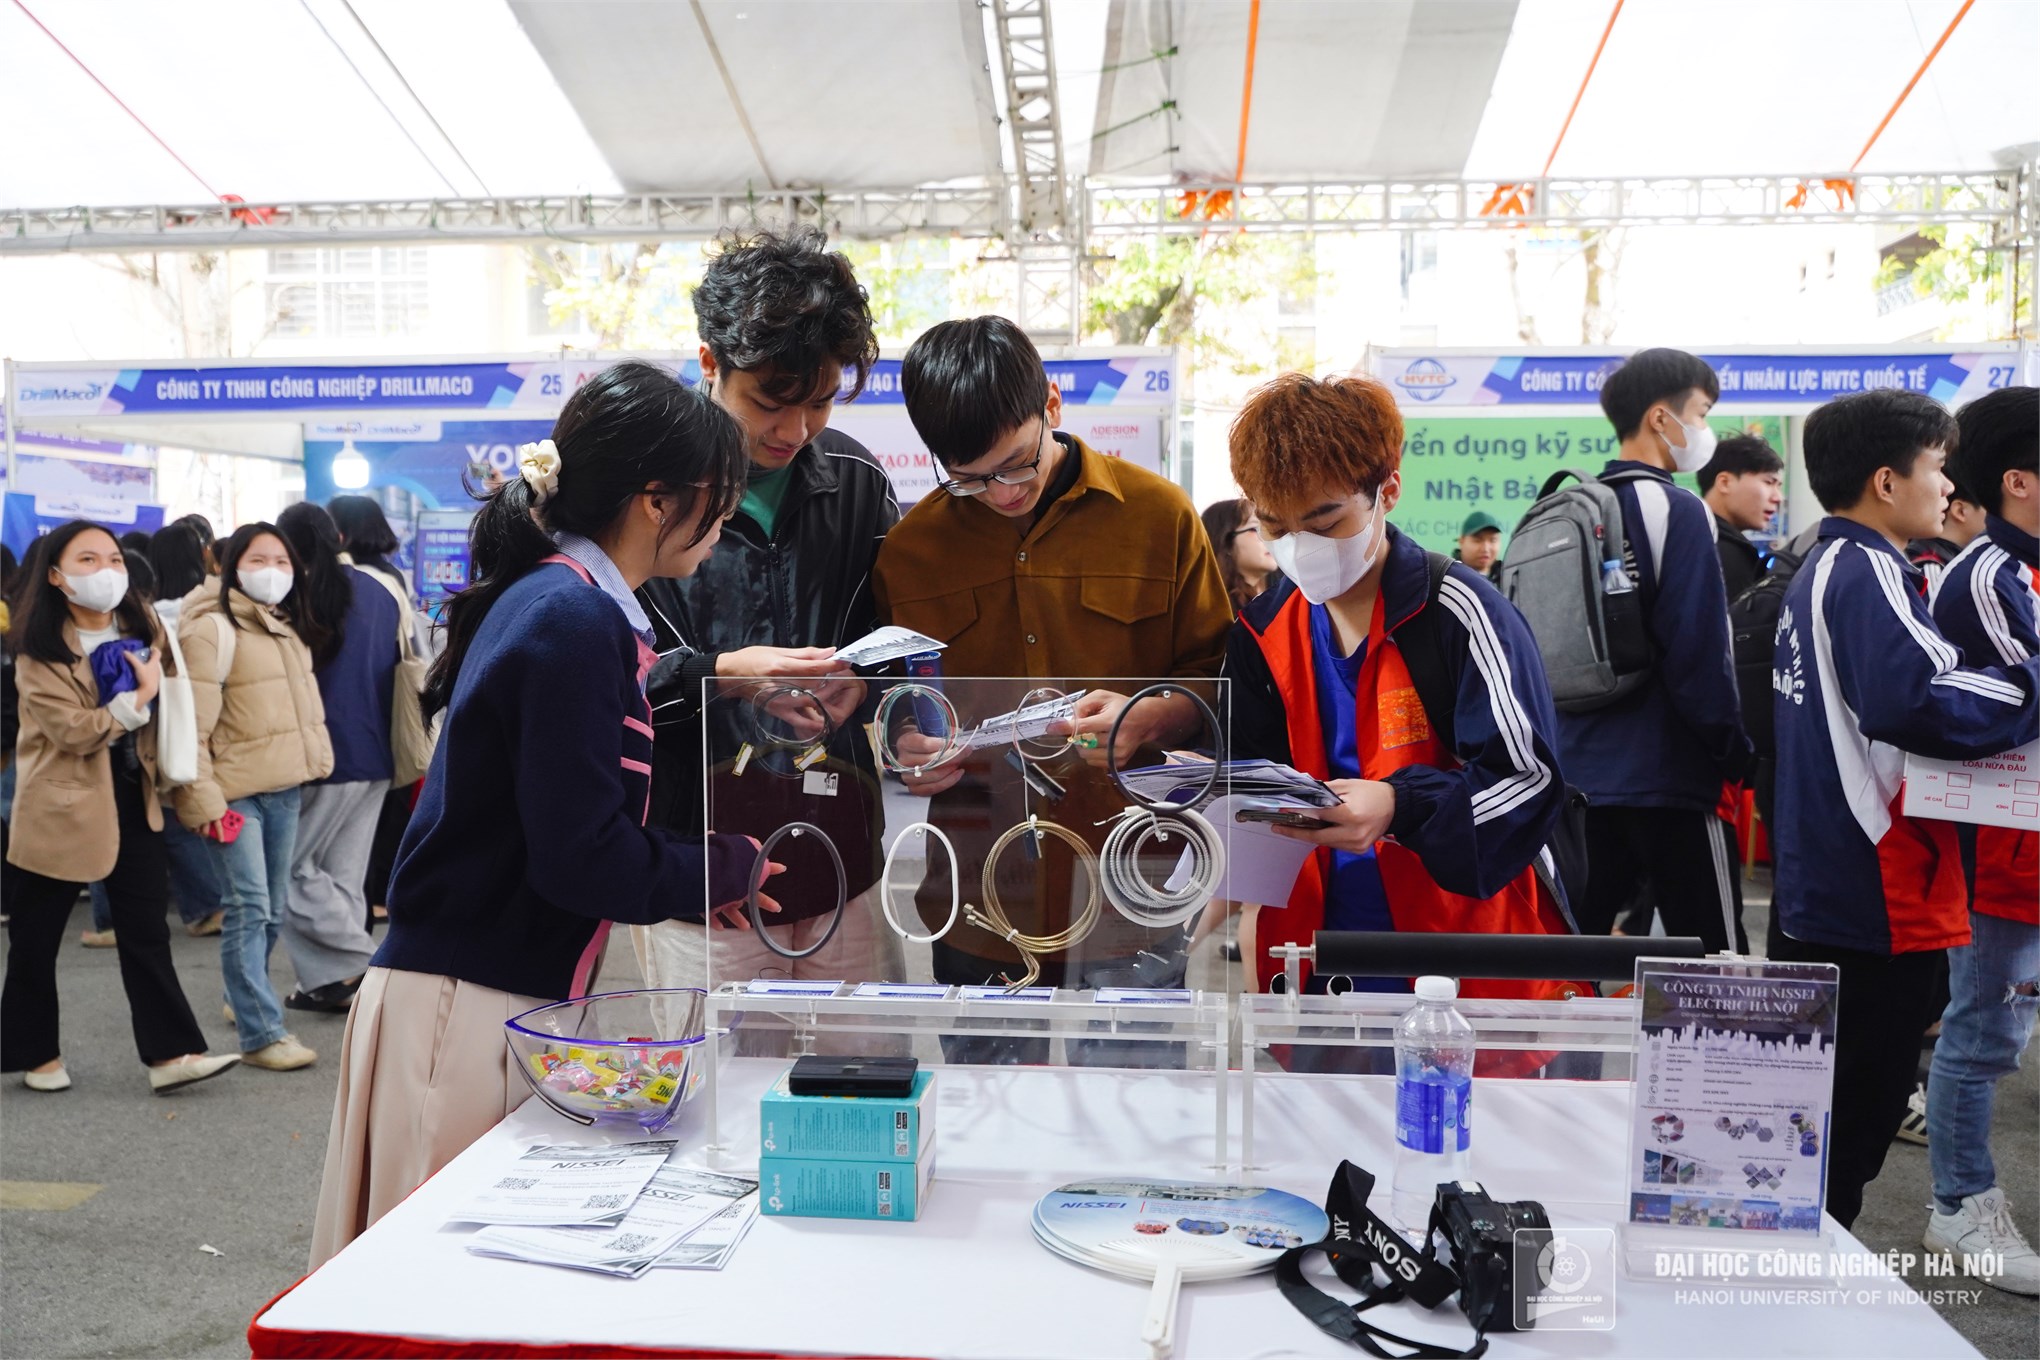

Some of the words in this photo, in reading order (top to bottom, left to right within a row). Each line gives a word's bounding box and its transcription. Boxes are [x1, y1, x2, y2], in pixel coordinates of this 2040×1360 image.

[156, 375, 199, 400] CÔNG
[202, 379, 222, 399] TY
[225, 379, 266, 399] TNHH
[270, 374, 314, 399] CÔNG
[318, 374, 377, 401] NGHIỆP
[381, 376, 474, 397] DRILLMACO
[541, 374, 562, 397] 25
[1144, 370, 1170, 392] 26
[1403, 373, 1448, 385] HVTC
[1521, 368, 1563, 392] CÔNG
[1565, 371, 1582, 391] TY
[1743, 366, 1786, 391] NHÂN
[1789, 368, 1819, 395] LỰC
[1821, 370, 1860, 390] HVTC
[1862, 362, 1904, 389] QUỐC
[1909, 362, 1928, 390] TẾ
[1988, 366, 2015, 388] 27
[1454, 434, 1526, 463] dụng
[1536, 431, 1571, 460] kỹ
[1578, 435, 1617, 454] sư
[1425, 478, 1494, 507] Nhật
[1962, 760, 1983, 770] LOẠI
[1985, 761, 2005, 771] NỬA
[1663, 981, 1704, 994] CÔNG
[1706, 983, 1727, 995] TY
[1728, 984, 1768, 999] TNHH
[1771, 987, 1816, 1001] NISSEI
[1678, 997, 1747, 1011] ELECTRIC
[1750, 998, 1771, 1013] HÀ
[1773, 1000, 1799, 1016] NỘI
[550, 1159, 626, 1169] NISSEI
[1364, 1221, 1422, 1282] SONY
